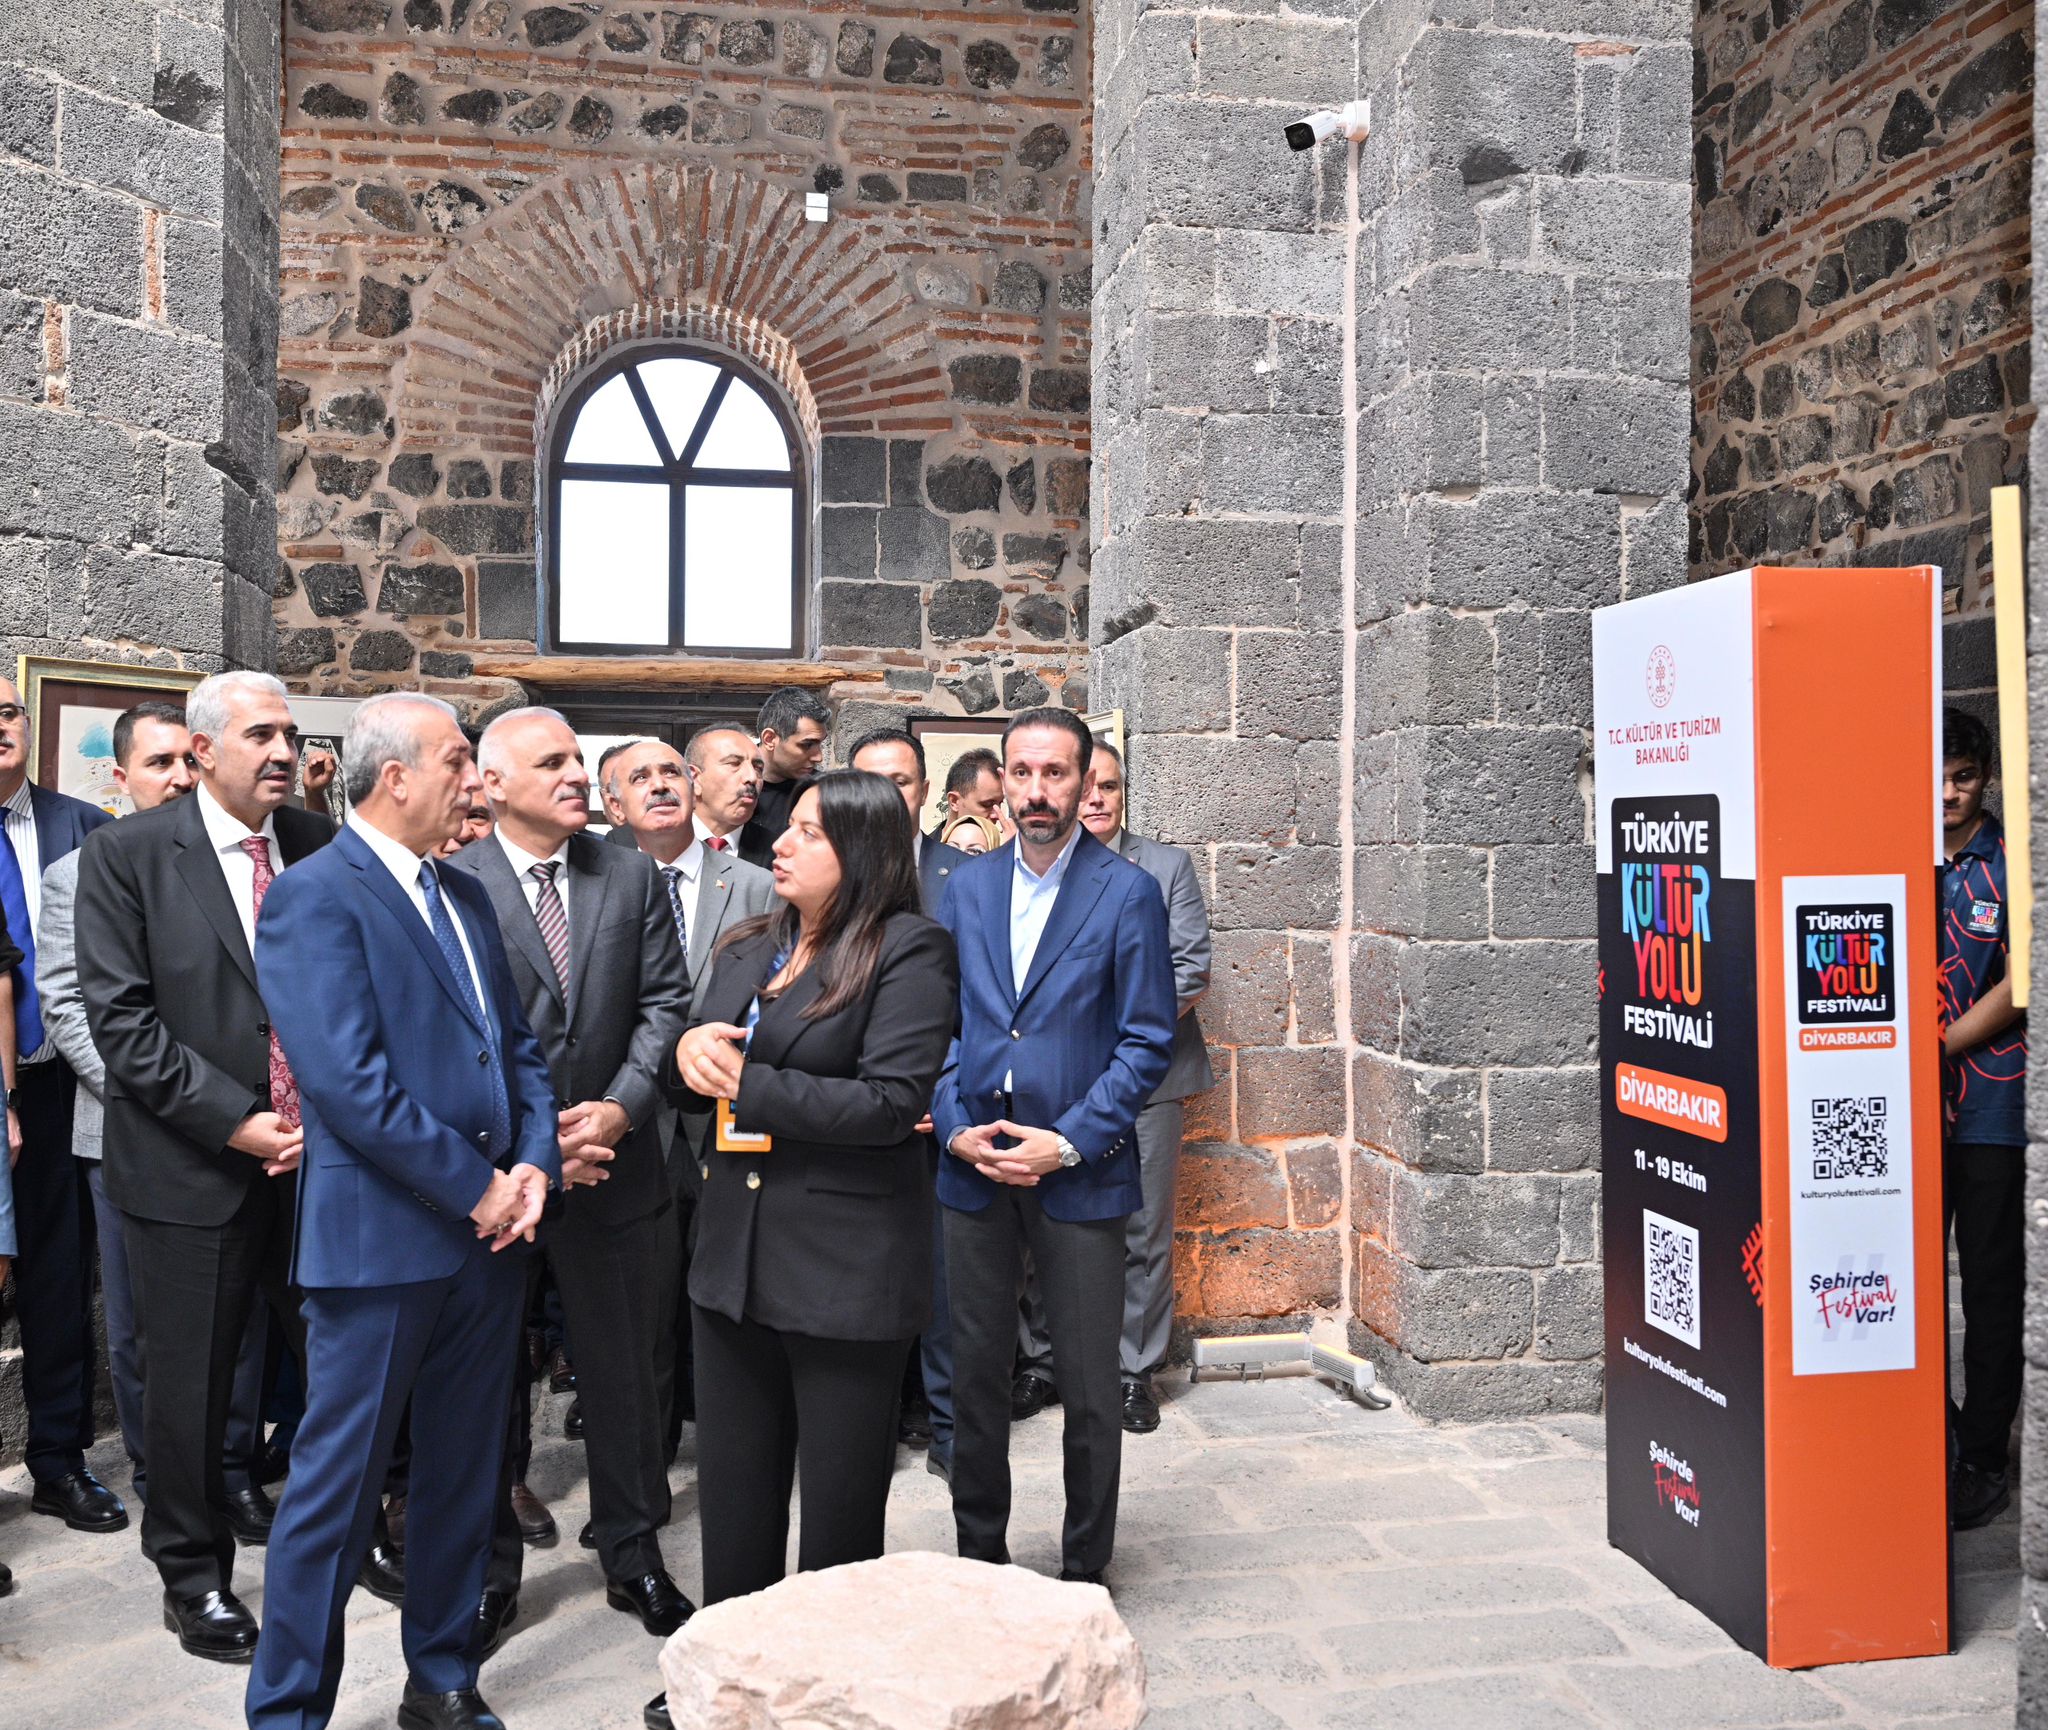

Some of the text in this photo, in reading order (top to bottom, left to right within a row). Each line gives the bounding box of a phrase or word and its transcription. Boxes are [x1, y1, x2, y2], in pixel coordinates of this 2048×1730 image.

[1608, 715, 1721, 745] T.C. KÜLTÜR VE TURİZM
[1636, 741, 1689, 765] BAKANLIĞI
[1620, 811, 1709, 854] TÜRKİYE
[1621, 862, 1711, 942] KÜLTÜR
[1805, 910, 1884, 930] TÜRKİYE
[1633, 930, 1703, 1006] YOLU
[1805, 933, 1886, 972] KÜLTÜR
[1817, 963, 1878, 997] YOLU
[1807, 994, 1887, 1014] FESTİVALİ
[1623, 1003, 1713, 1049] FESTİVALİ
[1802, 1029, 1892, 1047] DİYARBAKIR
[1620, 1070, 1721, 1128] DİYARBAKIR
[1634, 1148, 1646, 1171] 11
[1655, 1155, 1670, 1179] 19
[1671, 1160, 1707, 1193] Ekim
[1801, 1187, 1902, 1199] kulturyolufestivali.com
[1809, 1270, 1886, 1293] Şehirde
[1816, 1275, 1897, 1329] Festival
[1855, 1305, 1896, 1324] Var!
[1623, 1336, 1728, 1408] kulturyolufestivali.com
[1649, 1440, 1694, 1483] Şehirde
[1674, 1495, 1700, 1527] Var!
